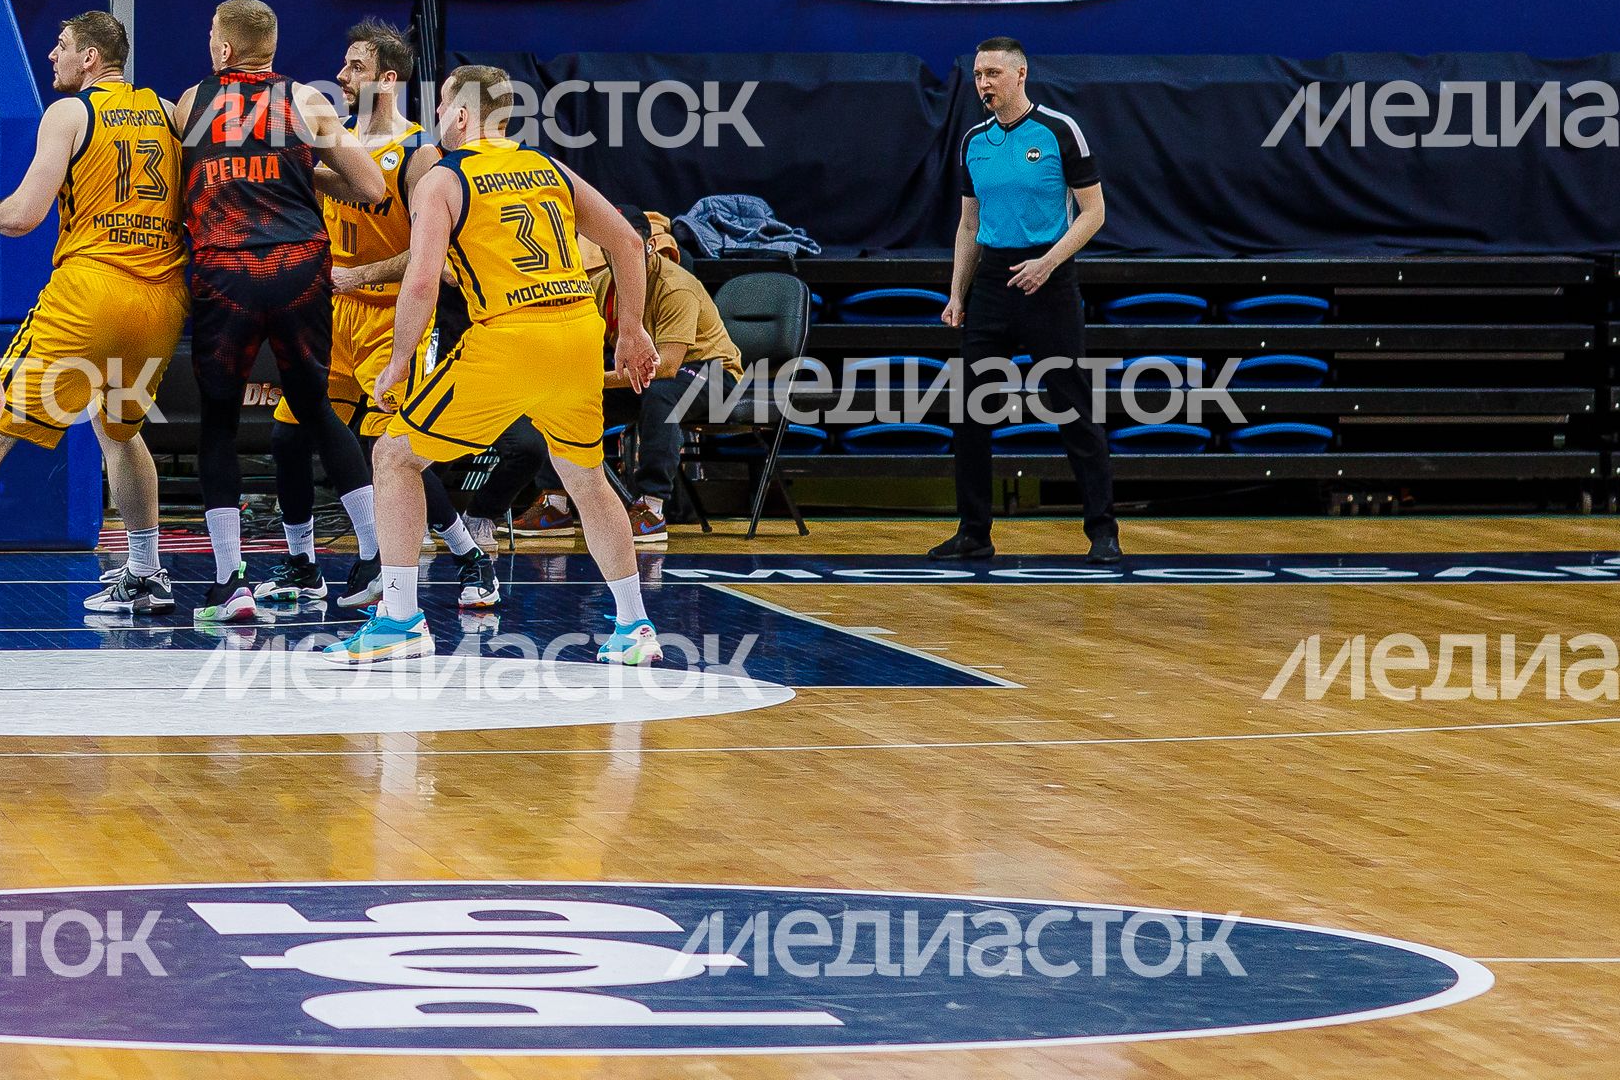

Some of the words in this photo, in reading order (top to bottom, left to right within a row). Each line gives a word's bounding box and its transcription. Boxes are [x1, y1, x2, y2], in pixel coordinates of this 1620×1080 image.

[212, 90, 269, 144] 21
[114, 140, 169, 202] 13
[205, 155, 281, 185] РЕВДА
[472, 169, 560, 195] ВАРНАКОВ
[109, 229, 169, 250] ОБЛАСТЬ
[500, 201, 574, 272] 31
